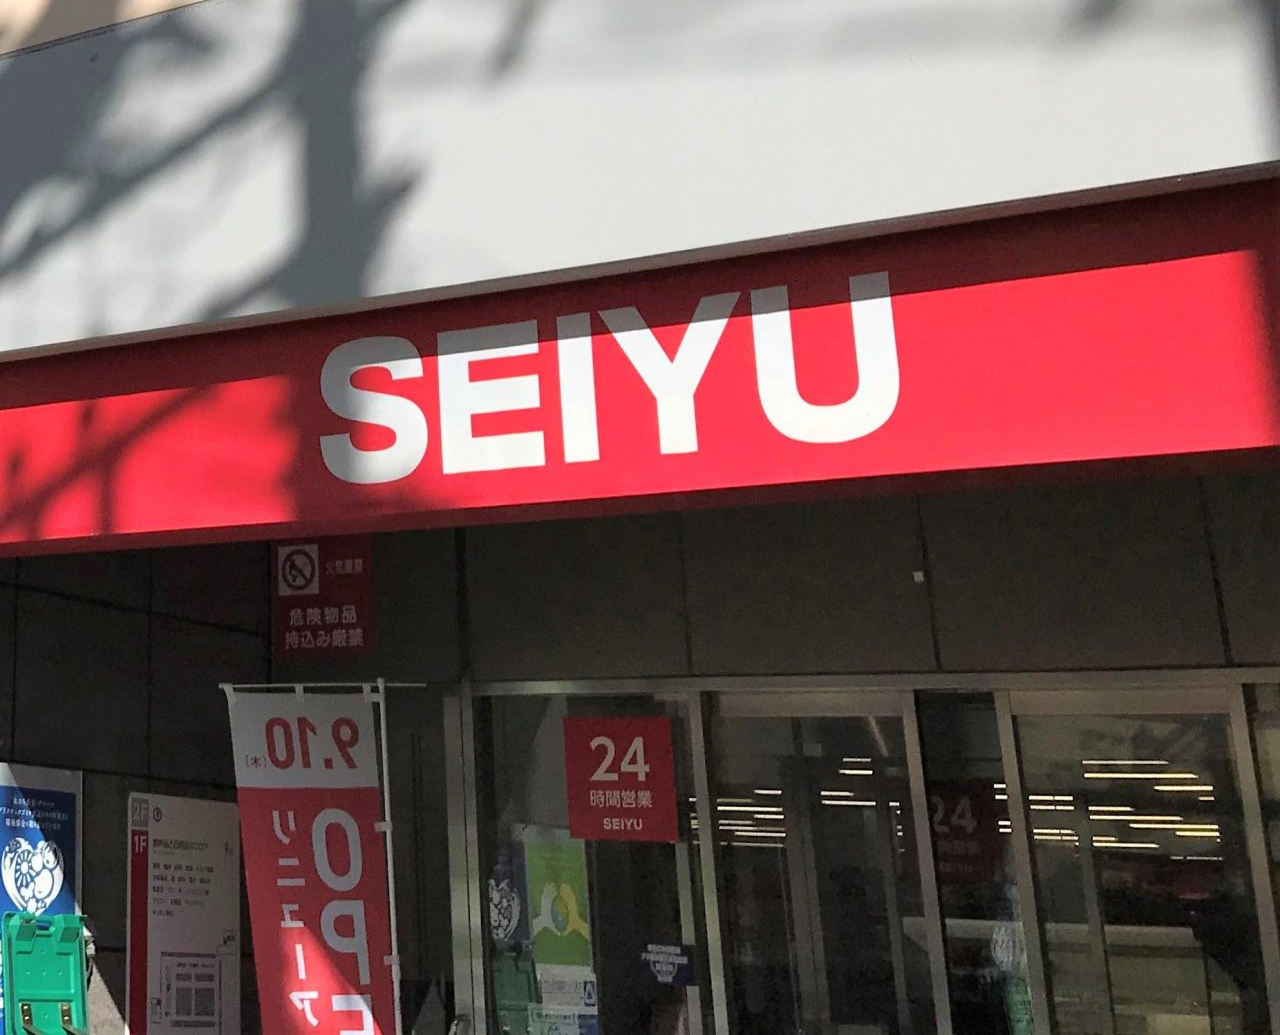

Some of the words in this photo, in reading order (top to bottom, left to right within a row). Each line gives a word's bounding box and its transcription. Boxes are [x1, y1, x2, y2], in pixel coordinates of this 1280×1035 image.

[320, 270, 901, 485] SEIYU
[289, 605, 357, 626] 危険物品
[590, 736, 650, 781] 24
[590, 789, 652, 807] 時間営業
[603, 817, 643, 830] SEIYU
[133, 834, 148, 853] 1F
